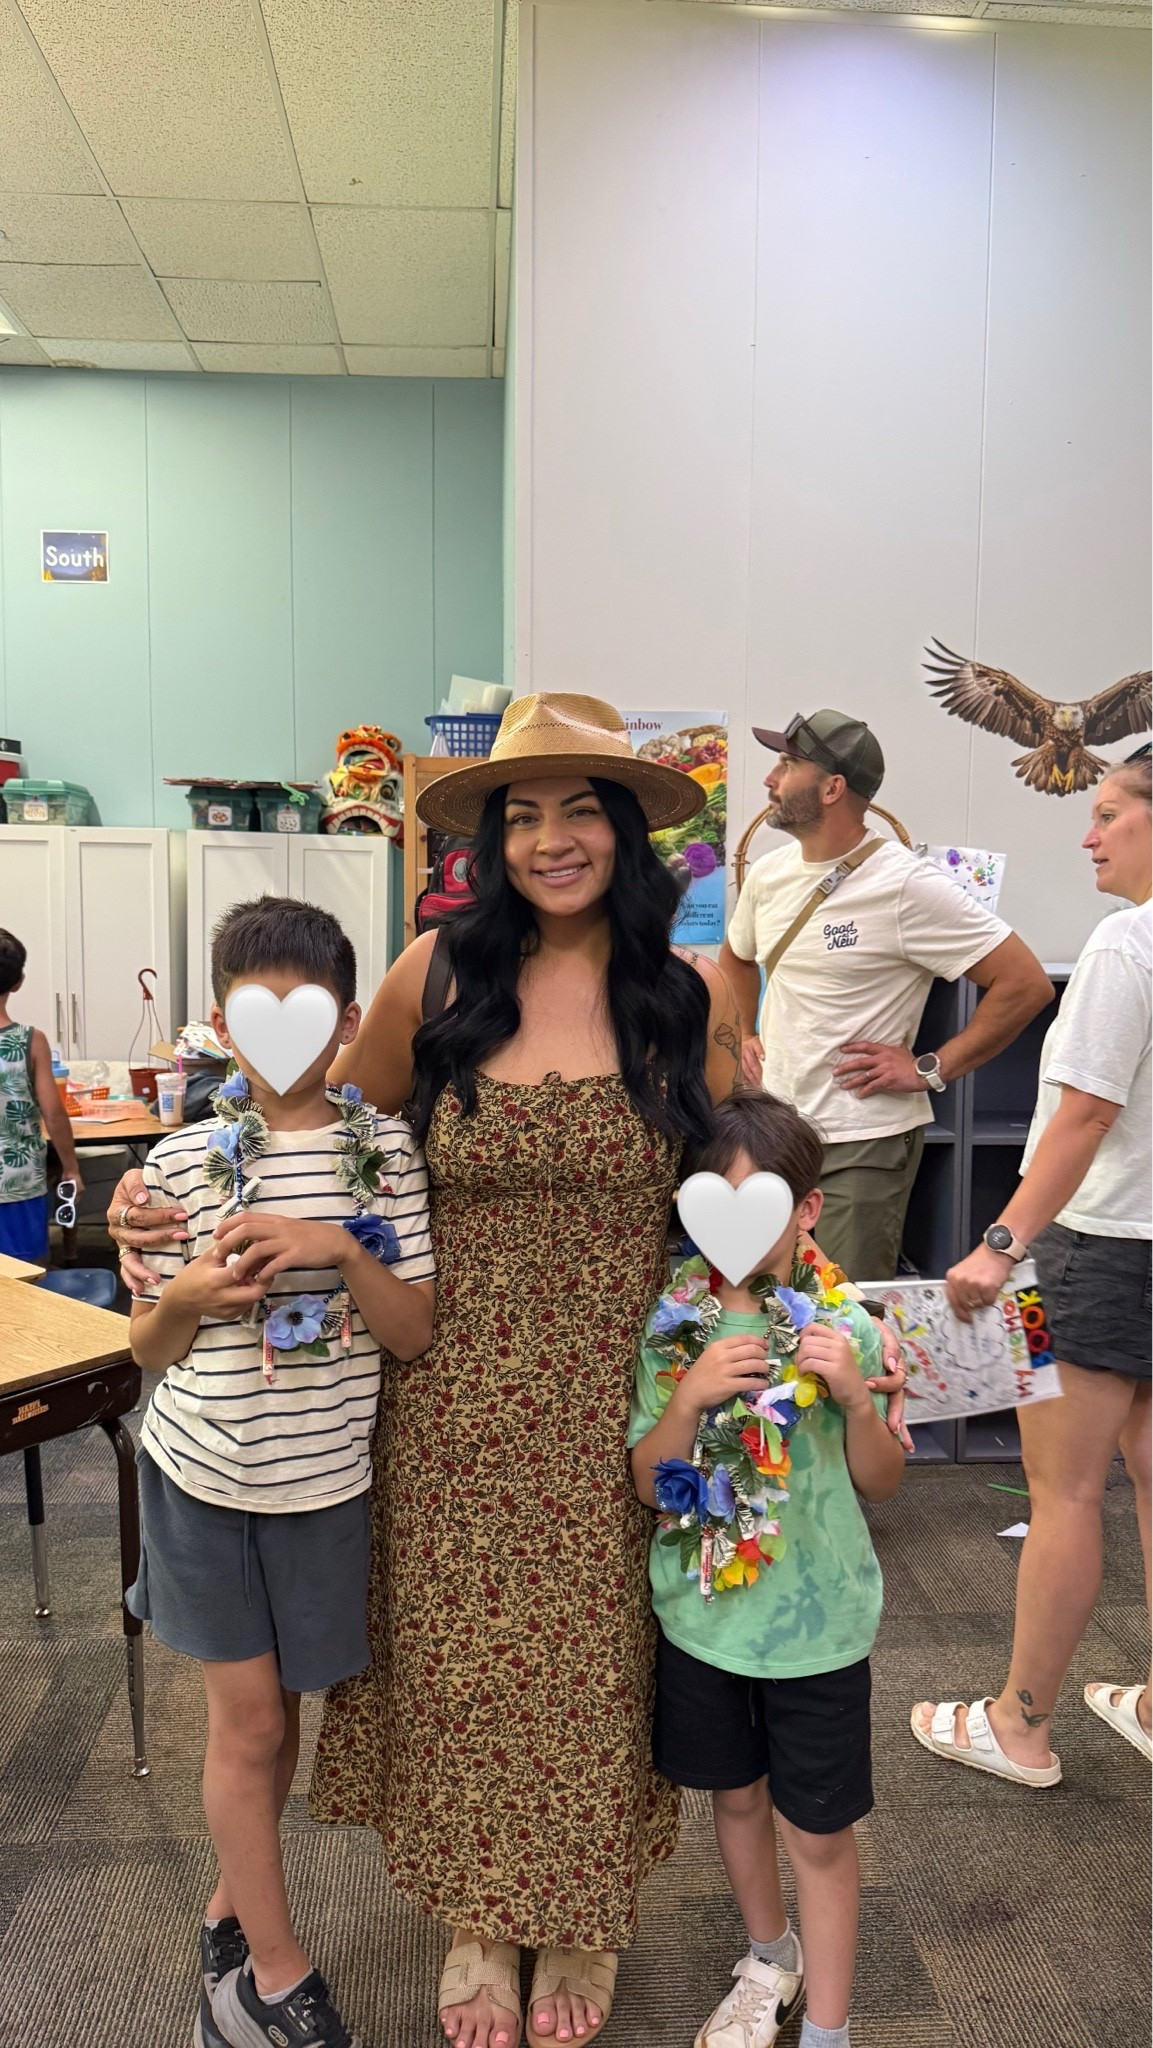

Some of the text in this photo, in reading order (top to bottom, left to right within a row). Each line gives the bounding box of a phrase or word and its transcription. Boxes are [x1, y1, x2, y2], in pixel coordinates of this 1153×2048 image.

[45, 545, 105, 568] South
[625, 717, 662, 730] inbow
[699, 919, 721, 928] today?
[823, 920, 858, 939] Good
[827, 935, 859, 950] New
